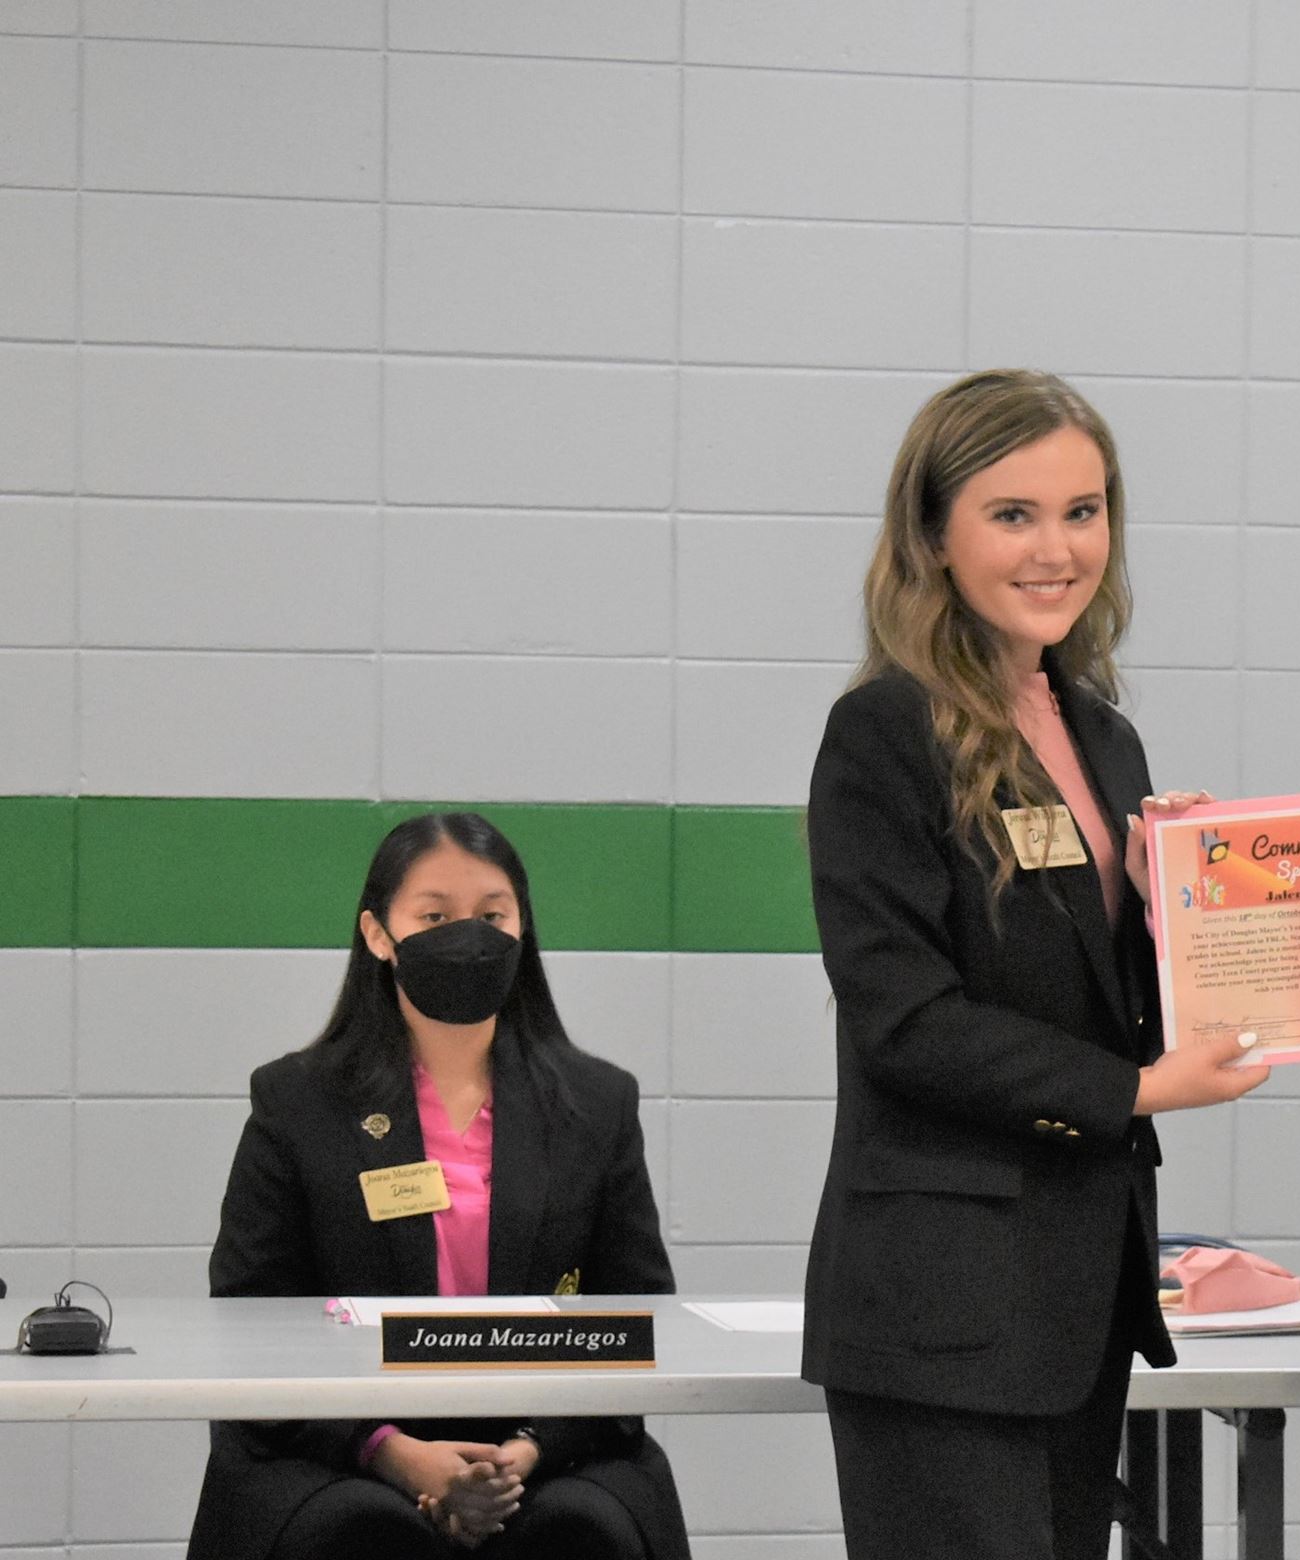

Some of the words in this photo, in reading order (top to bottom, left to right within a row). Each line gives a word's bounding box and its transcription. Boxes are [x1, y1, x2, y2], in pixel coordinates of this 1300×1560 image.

[1205, 931, 1220, 940] City
[1230, 928, 1257, 937] Douglas
[1259, 925, 1287, 935] Mayor's
[409, 1328, 482, 1347] Joana
[488, 1328, 628, 1350] Mazariegos
